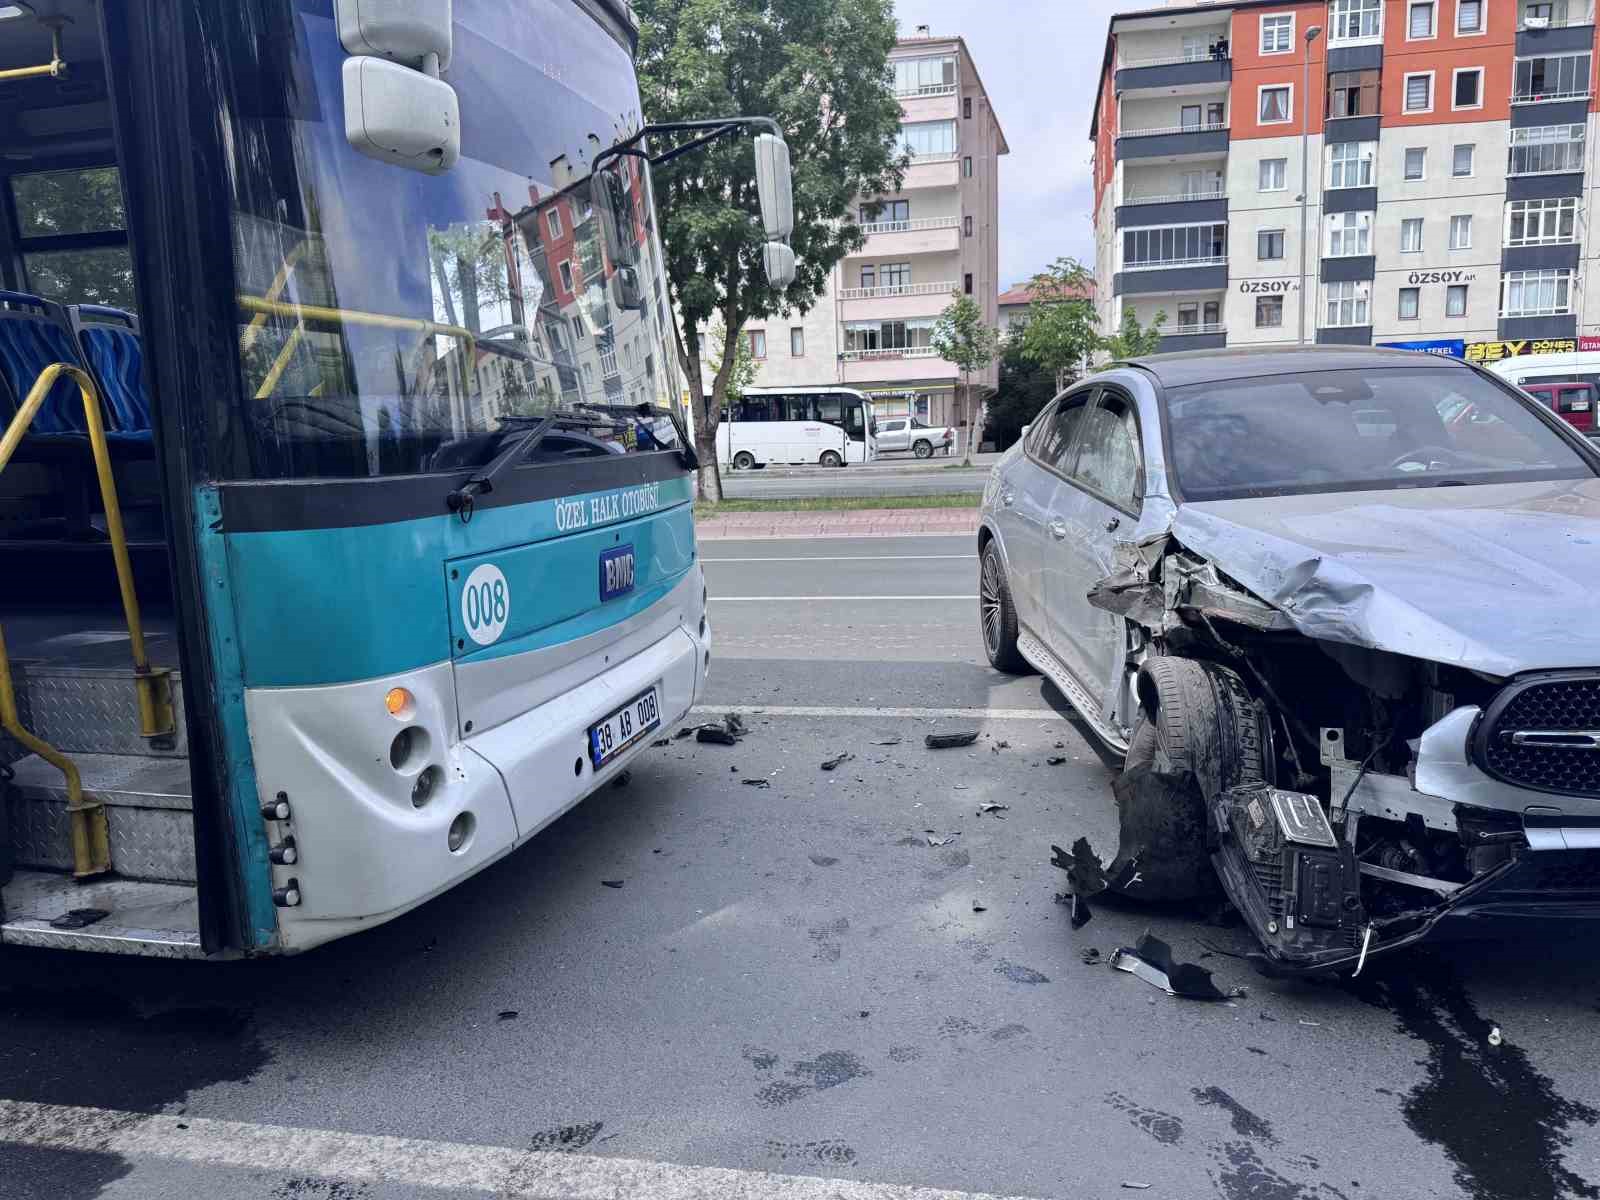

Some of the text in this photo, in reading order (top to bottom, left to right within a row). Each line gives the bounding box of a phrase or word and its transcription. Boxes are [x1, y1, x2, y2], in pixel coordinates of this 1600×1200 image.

[1240, 280, 1291, 293] ÖZSOY
[1408, 271, 1463, 284] ÖZSOY
[1465, 341, 1527, 361] BEY
[554, 481, 659, 532] ÖZEL HALK OTOBÜSÜ
[605, 553, 634, 593] BMC
[467, 579, 506, 630] 008
[598, 723, 613, 755] 38
[619, 710, 632, 741] AB
[637, 695, 656, 726] 008
